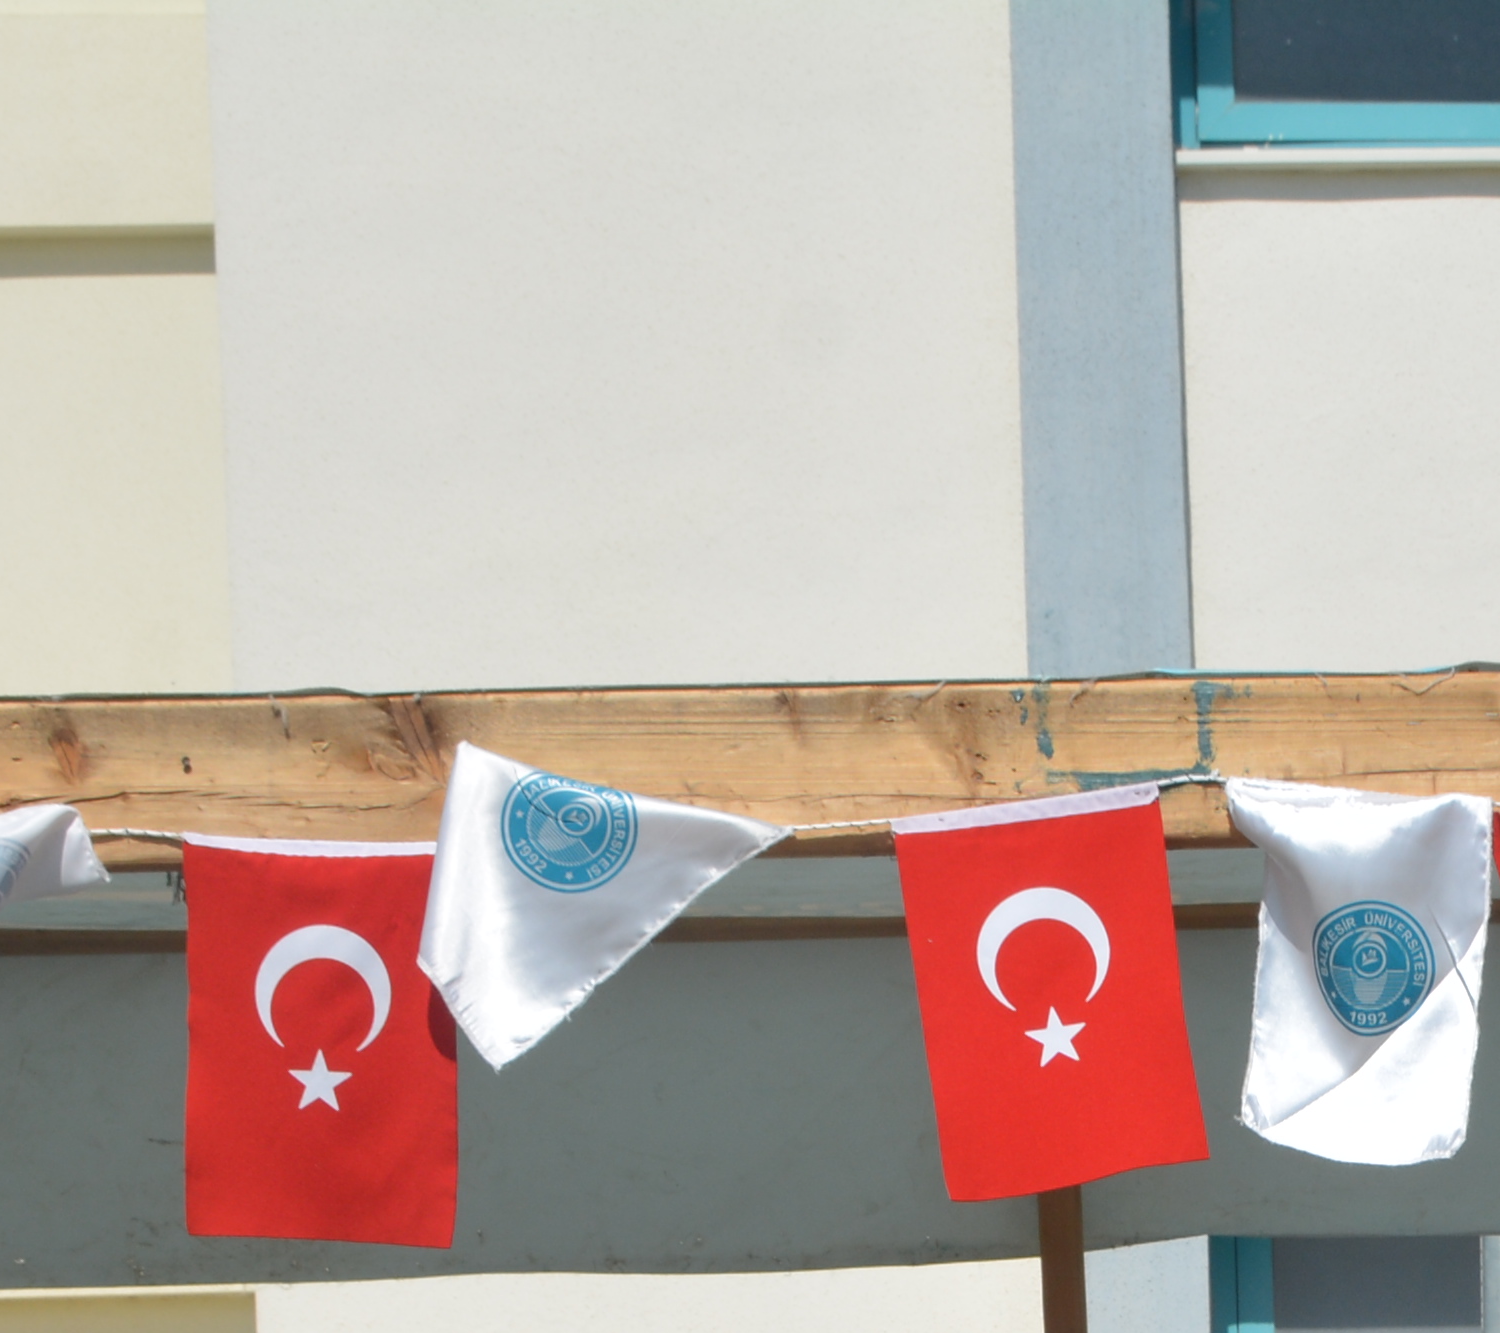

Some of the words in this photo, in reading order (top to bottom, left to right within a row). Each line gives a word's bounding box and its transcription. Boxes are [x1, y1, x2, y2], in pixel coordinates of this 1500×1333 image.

[516, 839, 547, 873] 1992
[1320, 915, 1356, 977] BALIKESİR
[1363, 910, 1425, 987] ÜNİVERSİTESİ
[1349, 1011, 1388, 1026] 1992
